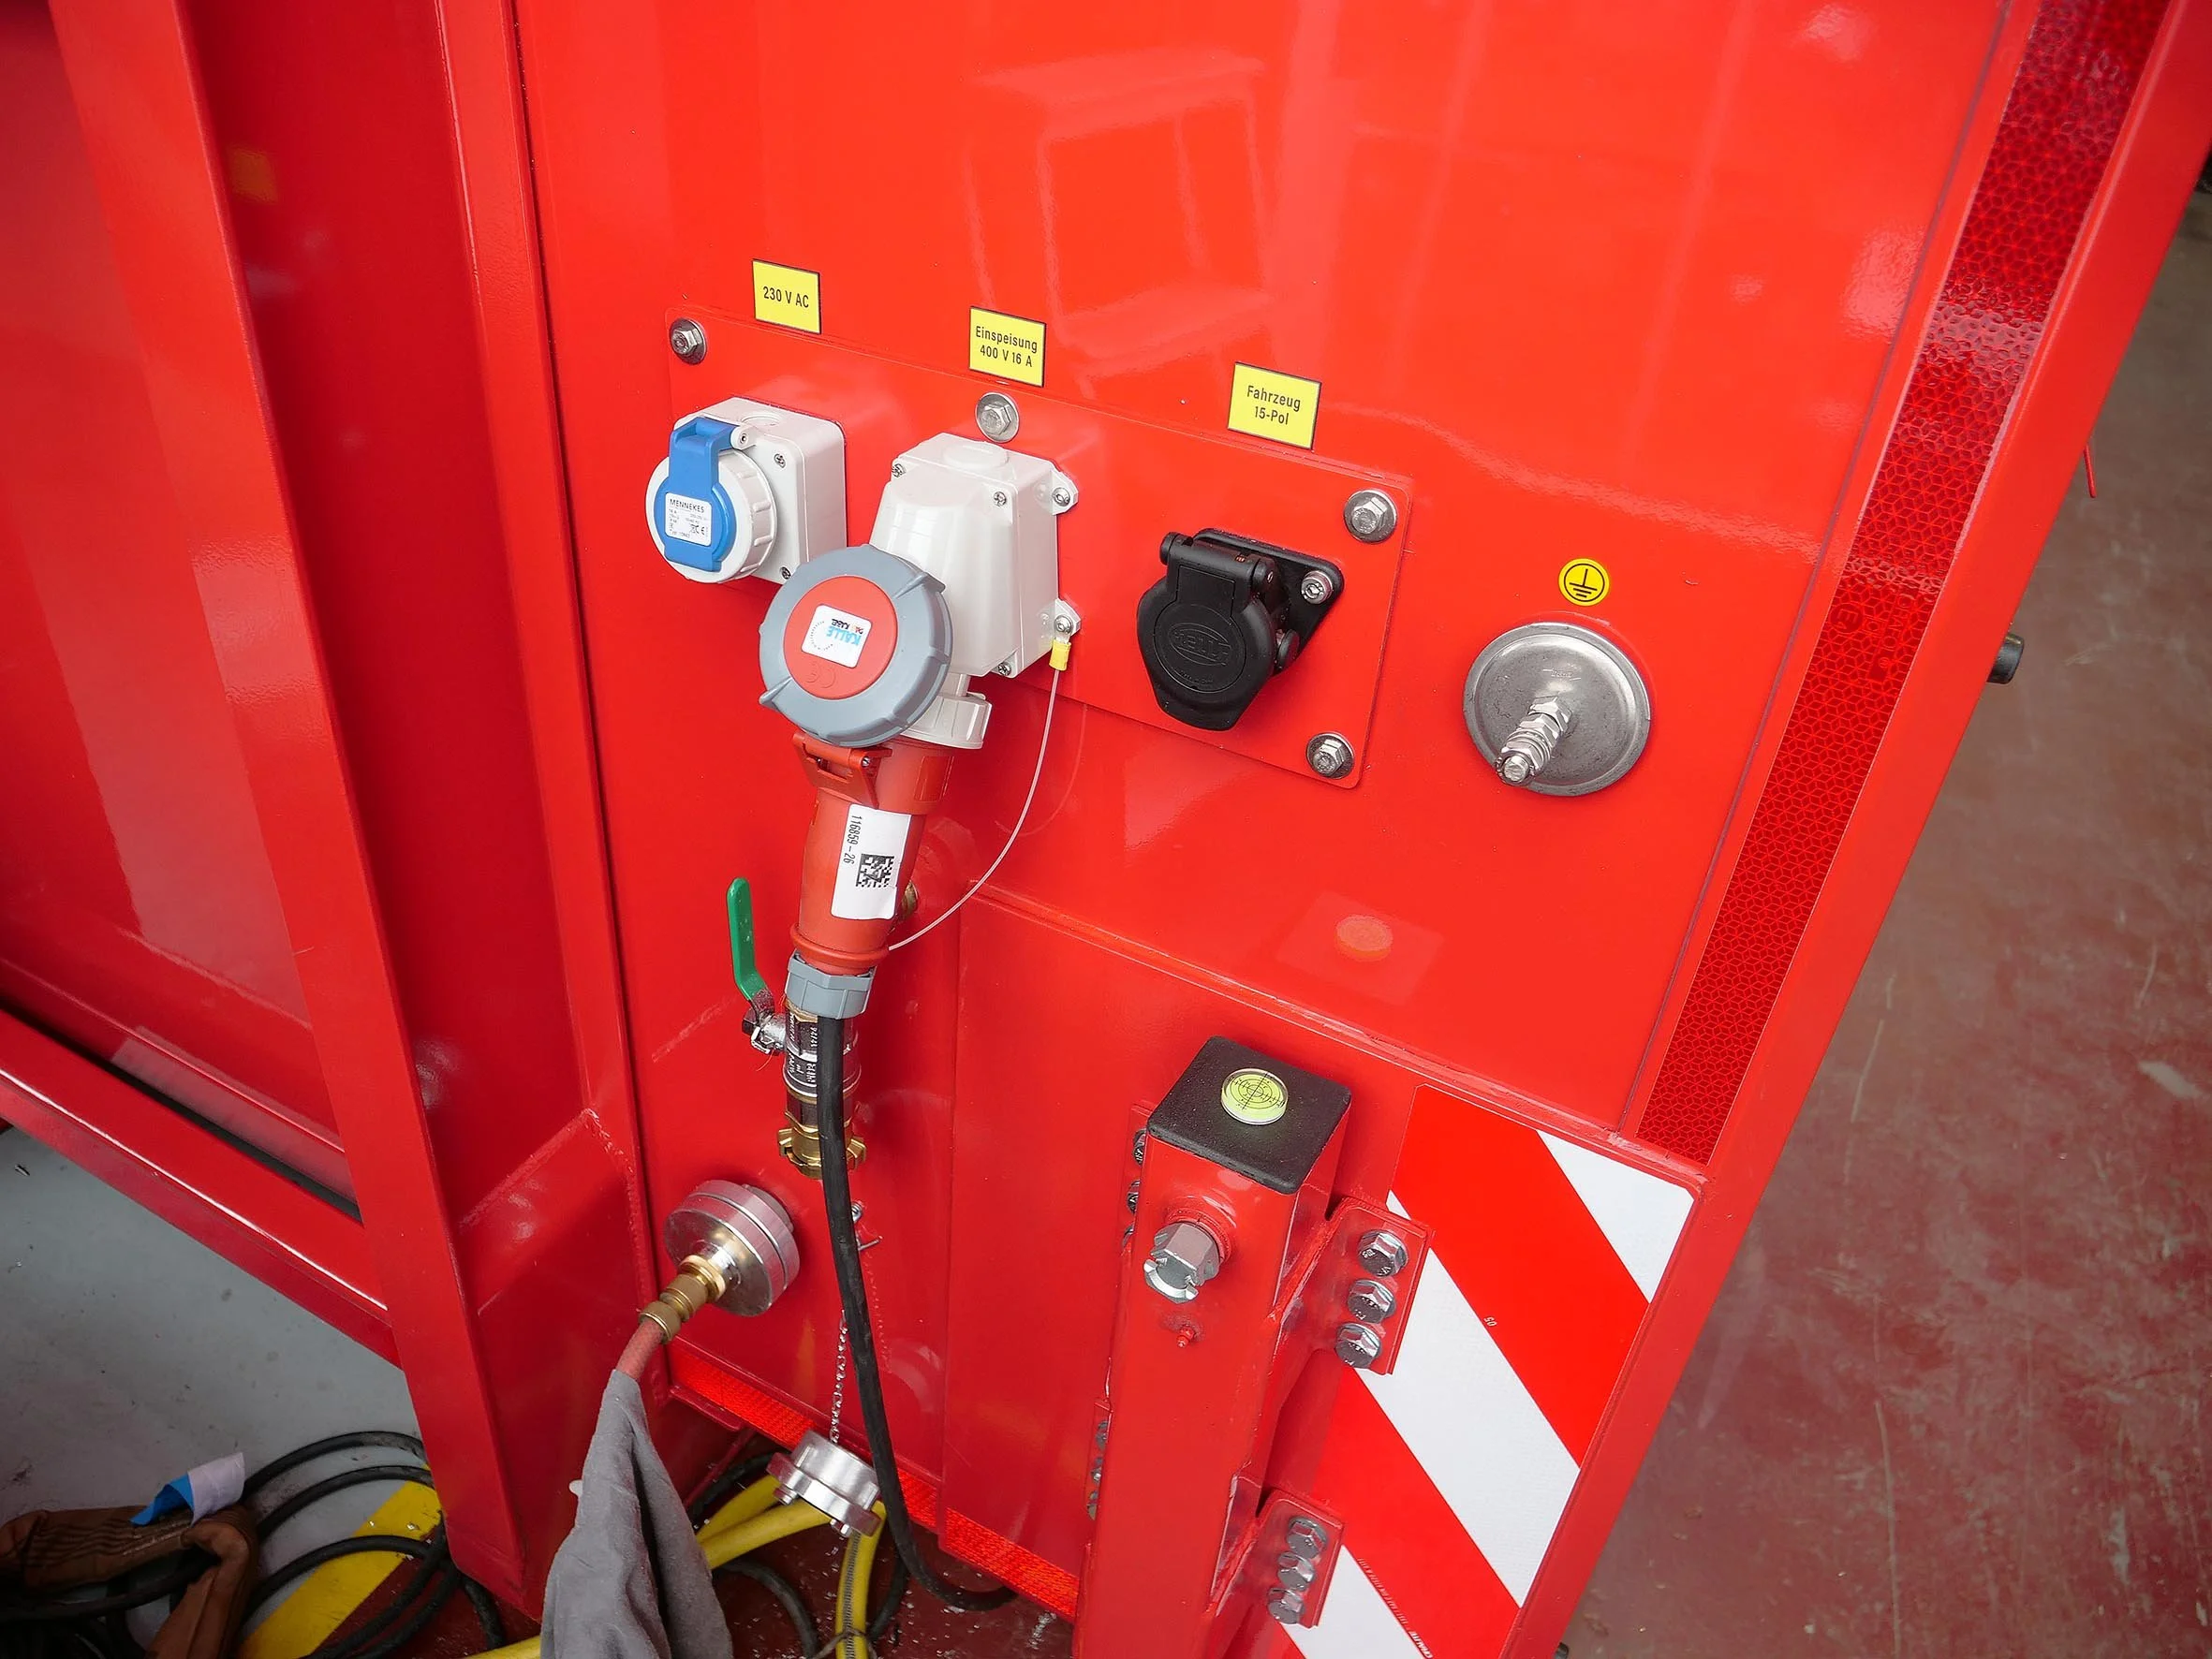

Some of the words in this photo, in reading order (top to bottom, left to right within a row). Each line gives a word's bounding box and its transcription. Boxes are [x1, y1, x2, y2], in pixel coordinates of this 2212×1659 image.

[763, 286, 782, 301] 230
[785, 290, 791, 304] V
[795, 293, 809, 308] AC
[976, 326, 1038, 354] Einspeisung
[980, 345, 998, 359] 400
[1002, 349, 1009, 361] V
[1012, 352, 1022, 364] 16
[1025, 355, 1032, 367] A
[1246, 385, 1301, 412] Fahrzeug
[1255, 405, 1289, 425] 15-Pol
[670, 498, 705, 513] MENNEKES
